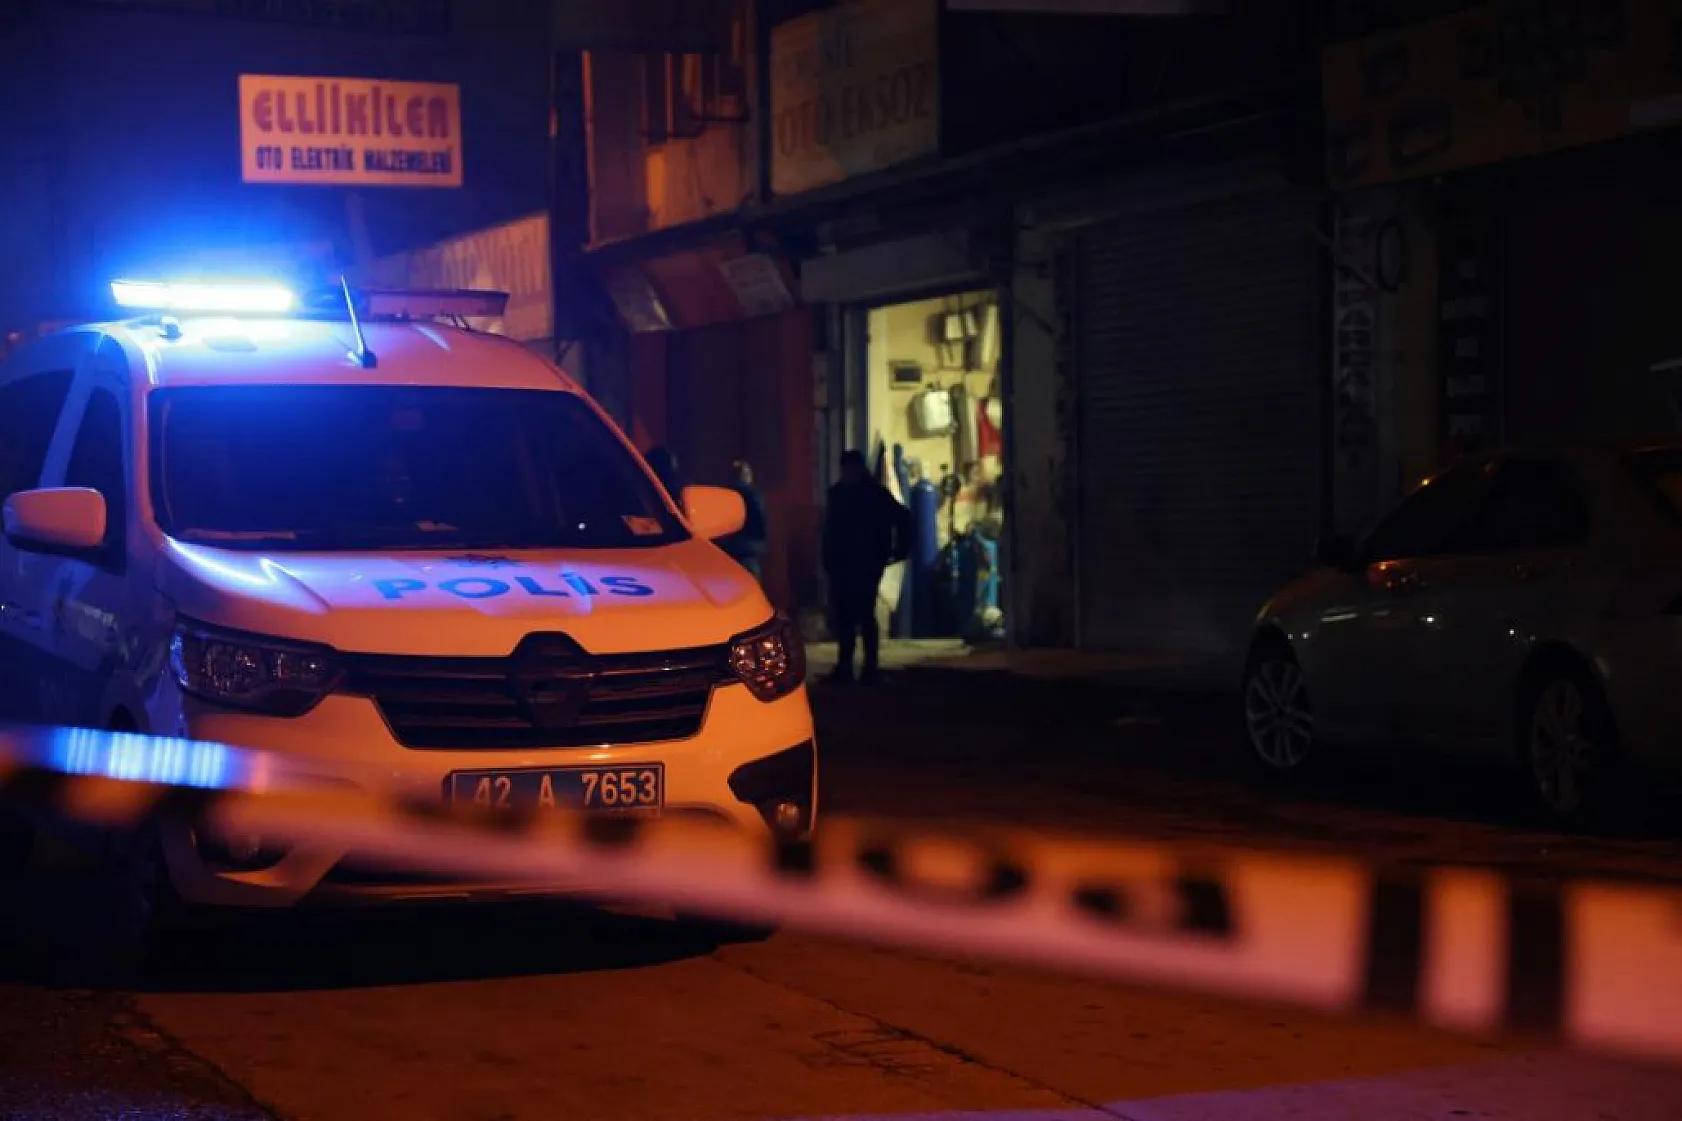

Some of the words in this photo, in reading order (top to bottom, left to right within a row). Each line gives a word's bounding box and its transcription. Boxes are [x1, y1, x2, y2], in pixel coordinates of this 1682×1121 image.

[256, 146, 282, 170] OTO
[291, 143, 355, 170] ELEKTRİK
[374, 572, 654, 599] POLİS
[474, 775, 512, 808] 42
[538, 773, 554, 807] A
[580, 770, 657, 806] 7653
